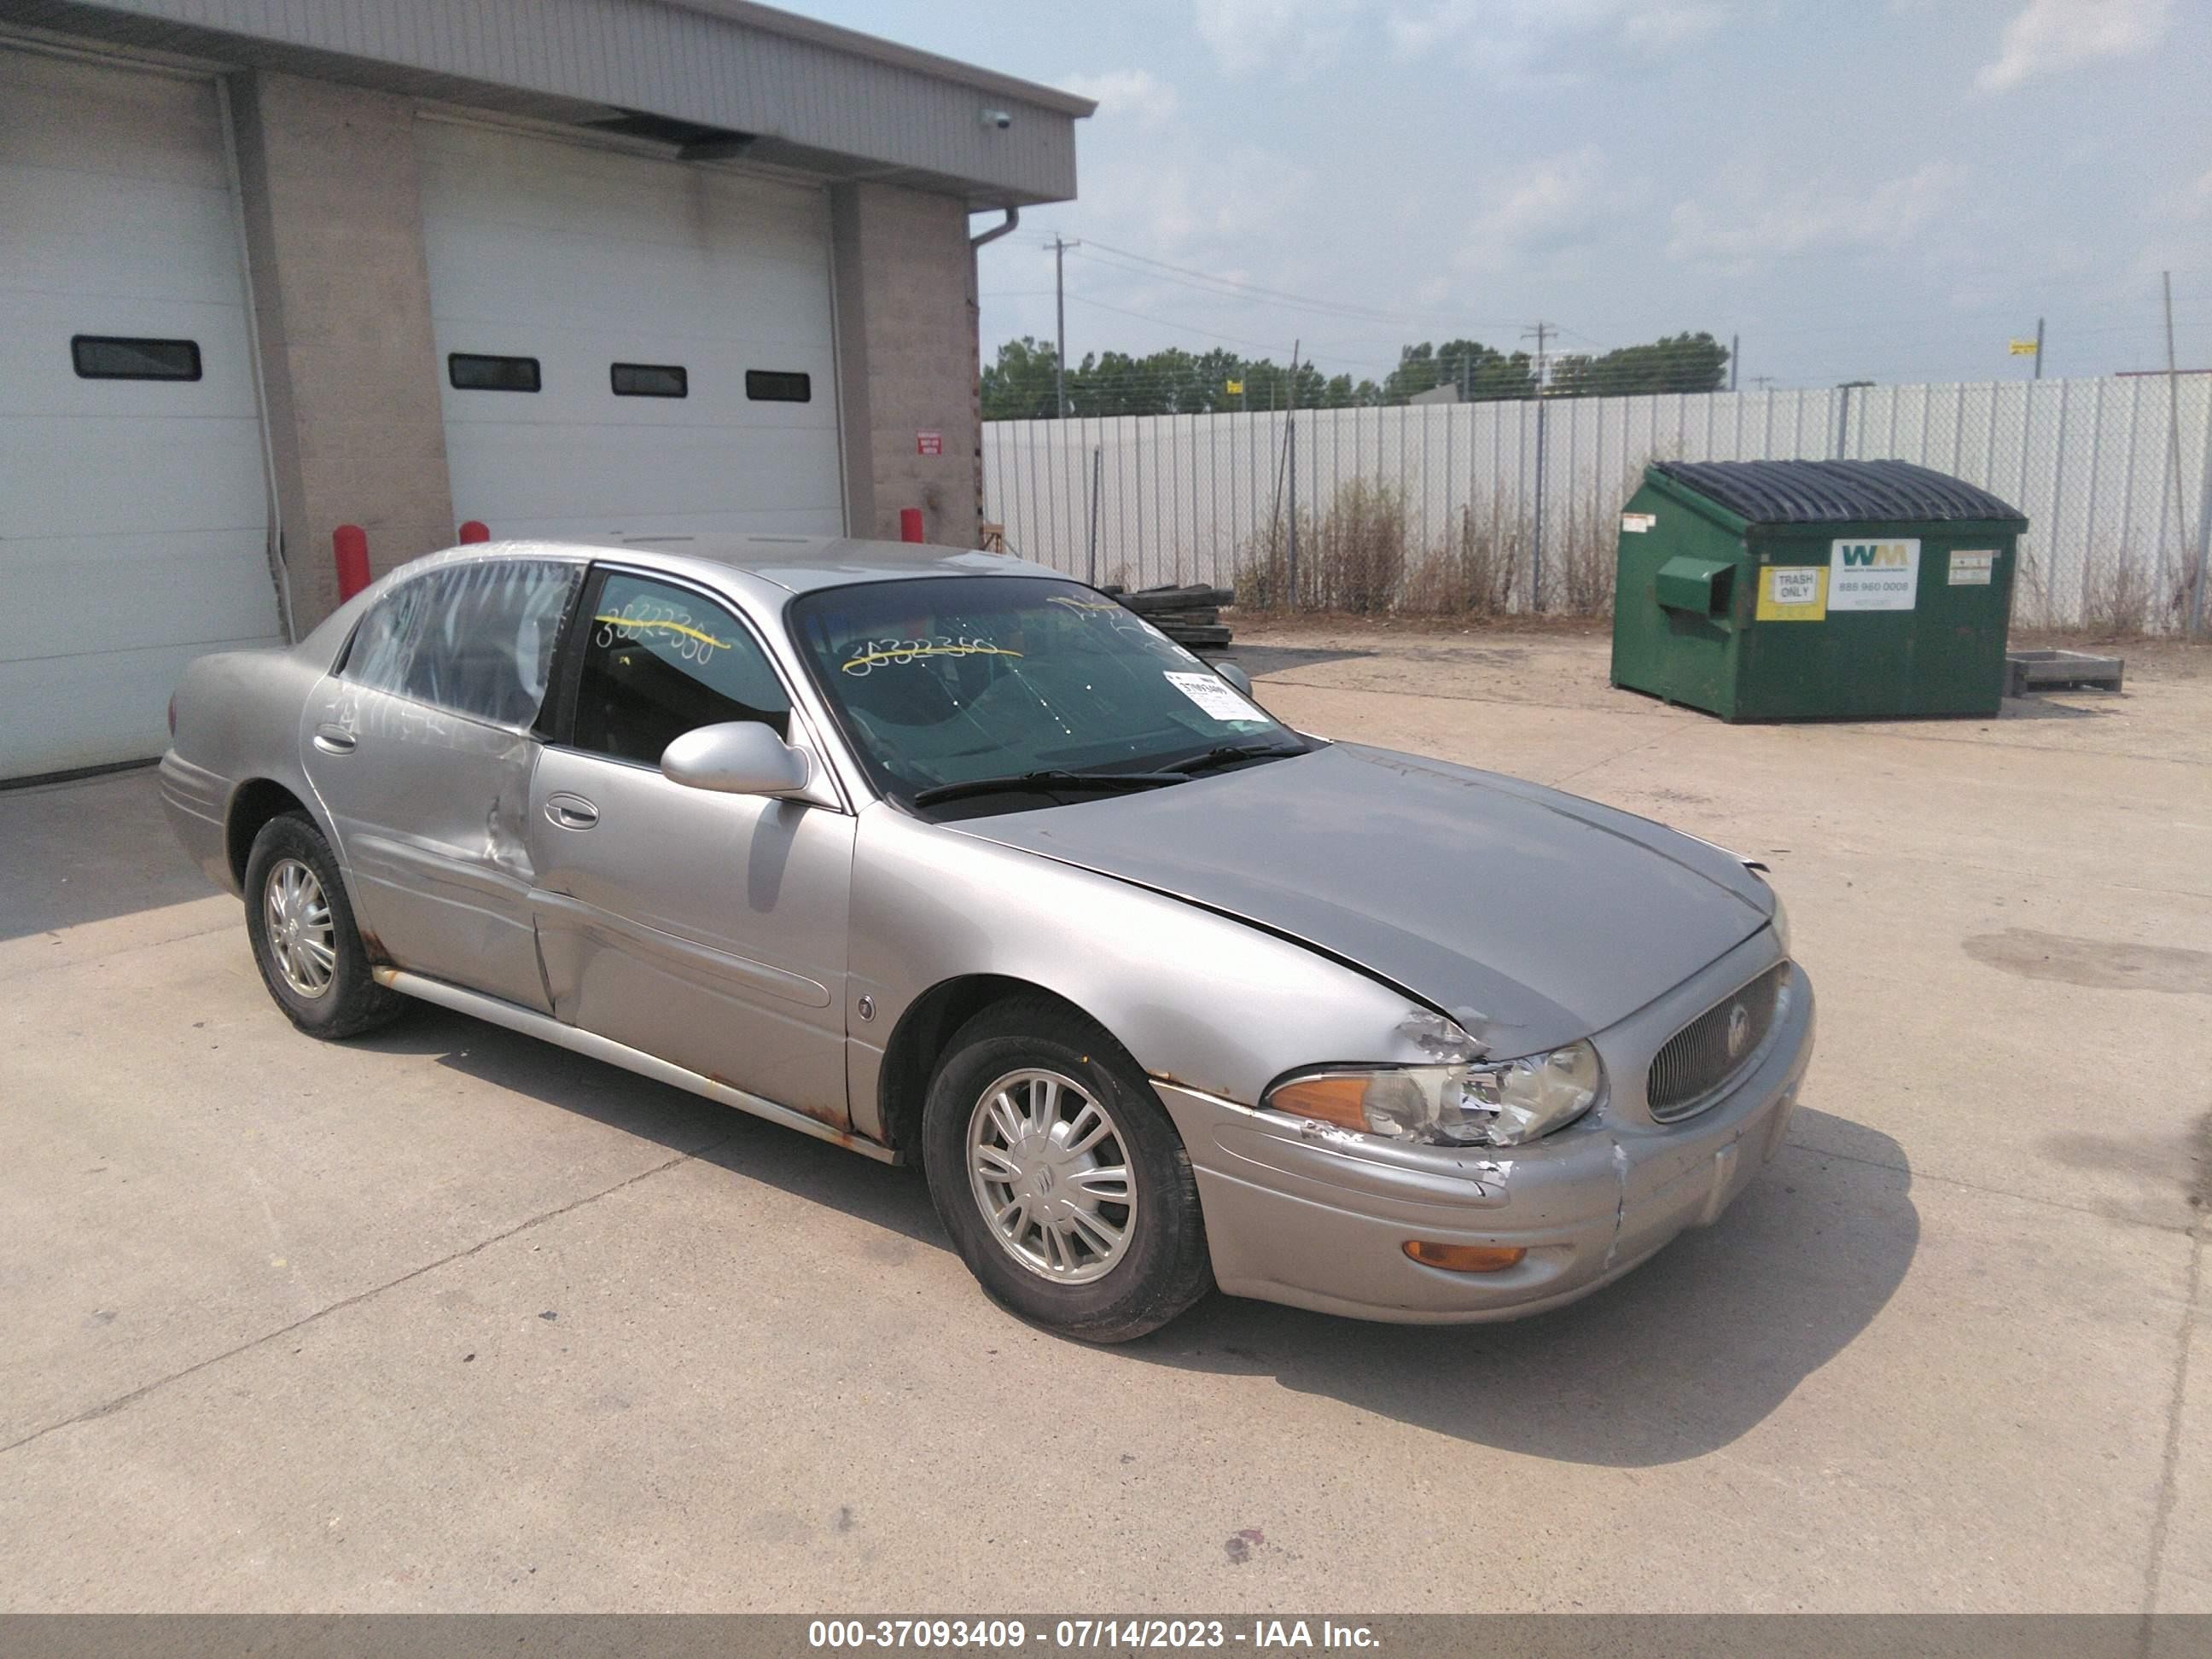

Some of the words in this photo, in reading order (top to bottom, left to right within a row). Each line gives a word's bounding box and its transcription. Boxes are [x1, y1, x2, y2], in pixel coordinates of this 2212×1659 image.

[1842, 545, 1909, 567] WM
[1779, 574, 1813, 586] TRASH
[1781, 586, 1809, 597] ONLY
[1838, 582, 1859, 591] 888
[1861, 582, 1881, 591] 960
